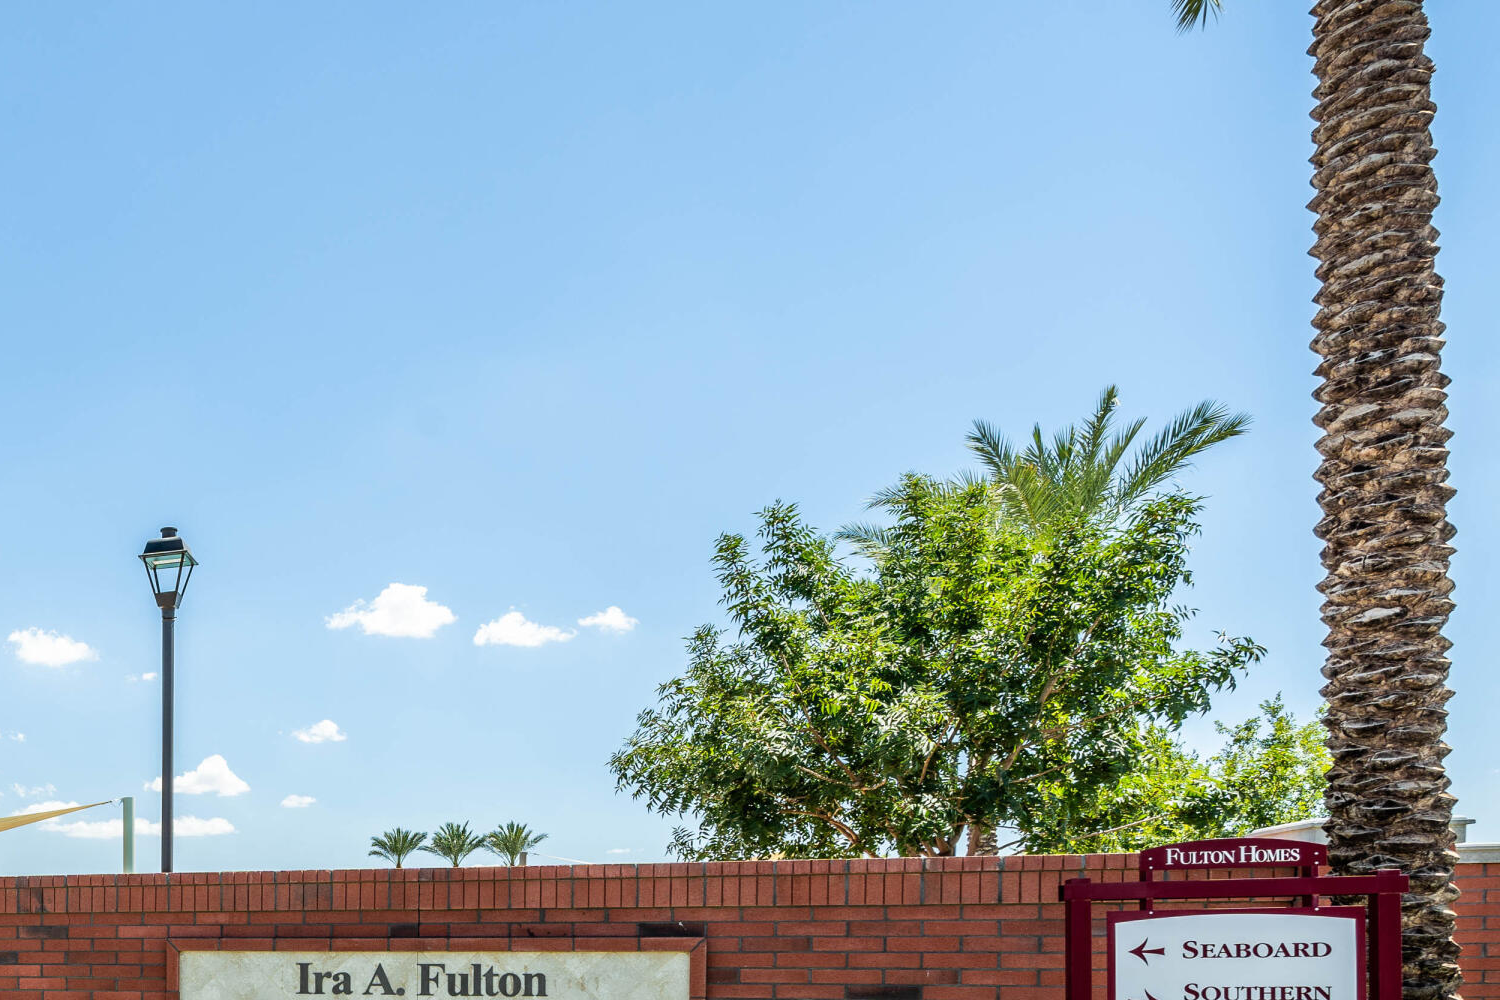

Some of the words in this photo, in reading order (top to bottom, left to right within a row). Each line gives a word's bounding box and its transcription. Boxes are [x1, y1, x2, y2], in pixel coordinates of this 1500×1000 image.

[1166, 848, 1236, 866] FULTON
[1239, 846, 1301, 863] HOMES
[1182, 940, 1332, 959] SEABOARD
[295, 962, 353, 996] Ira
[362, 963, 406, 997] A.
[417, 963, 548, 998] Fulton
